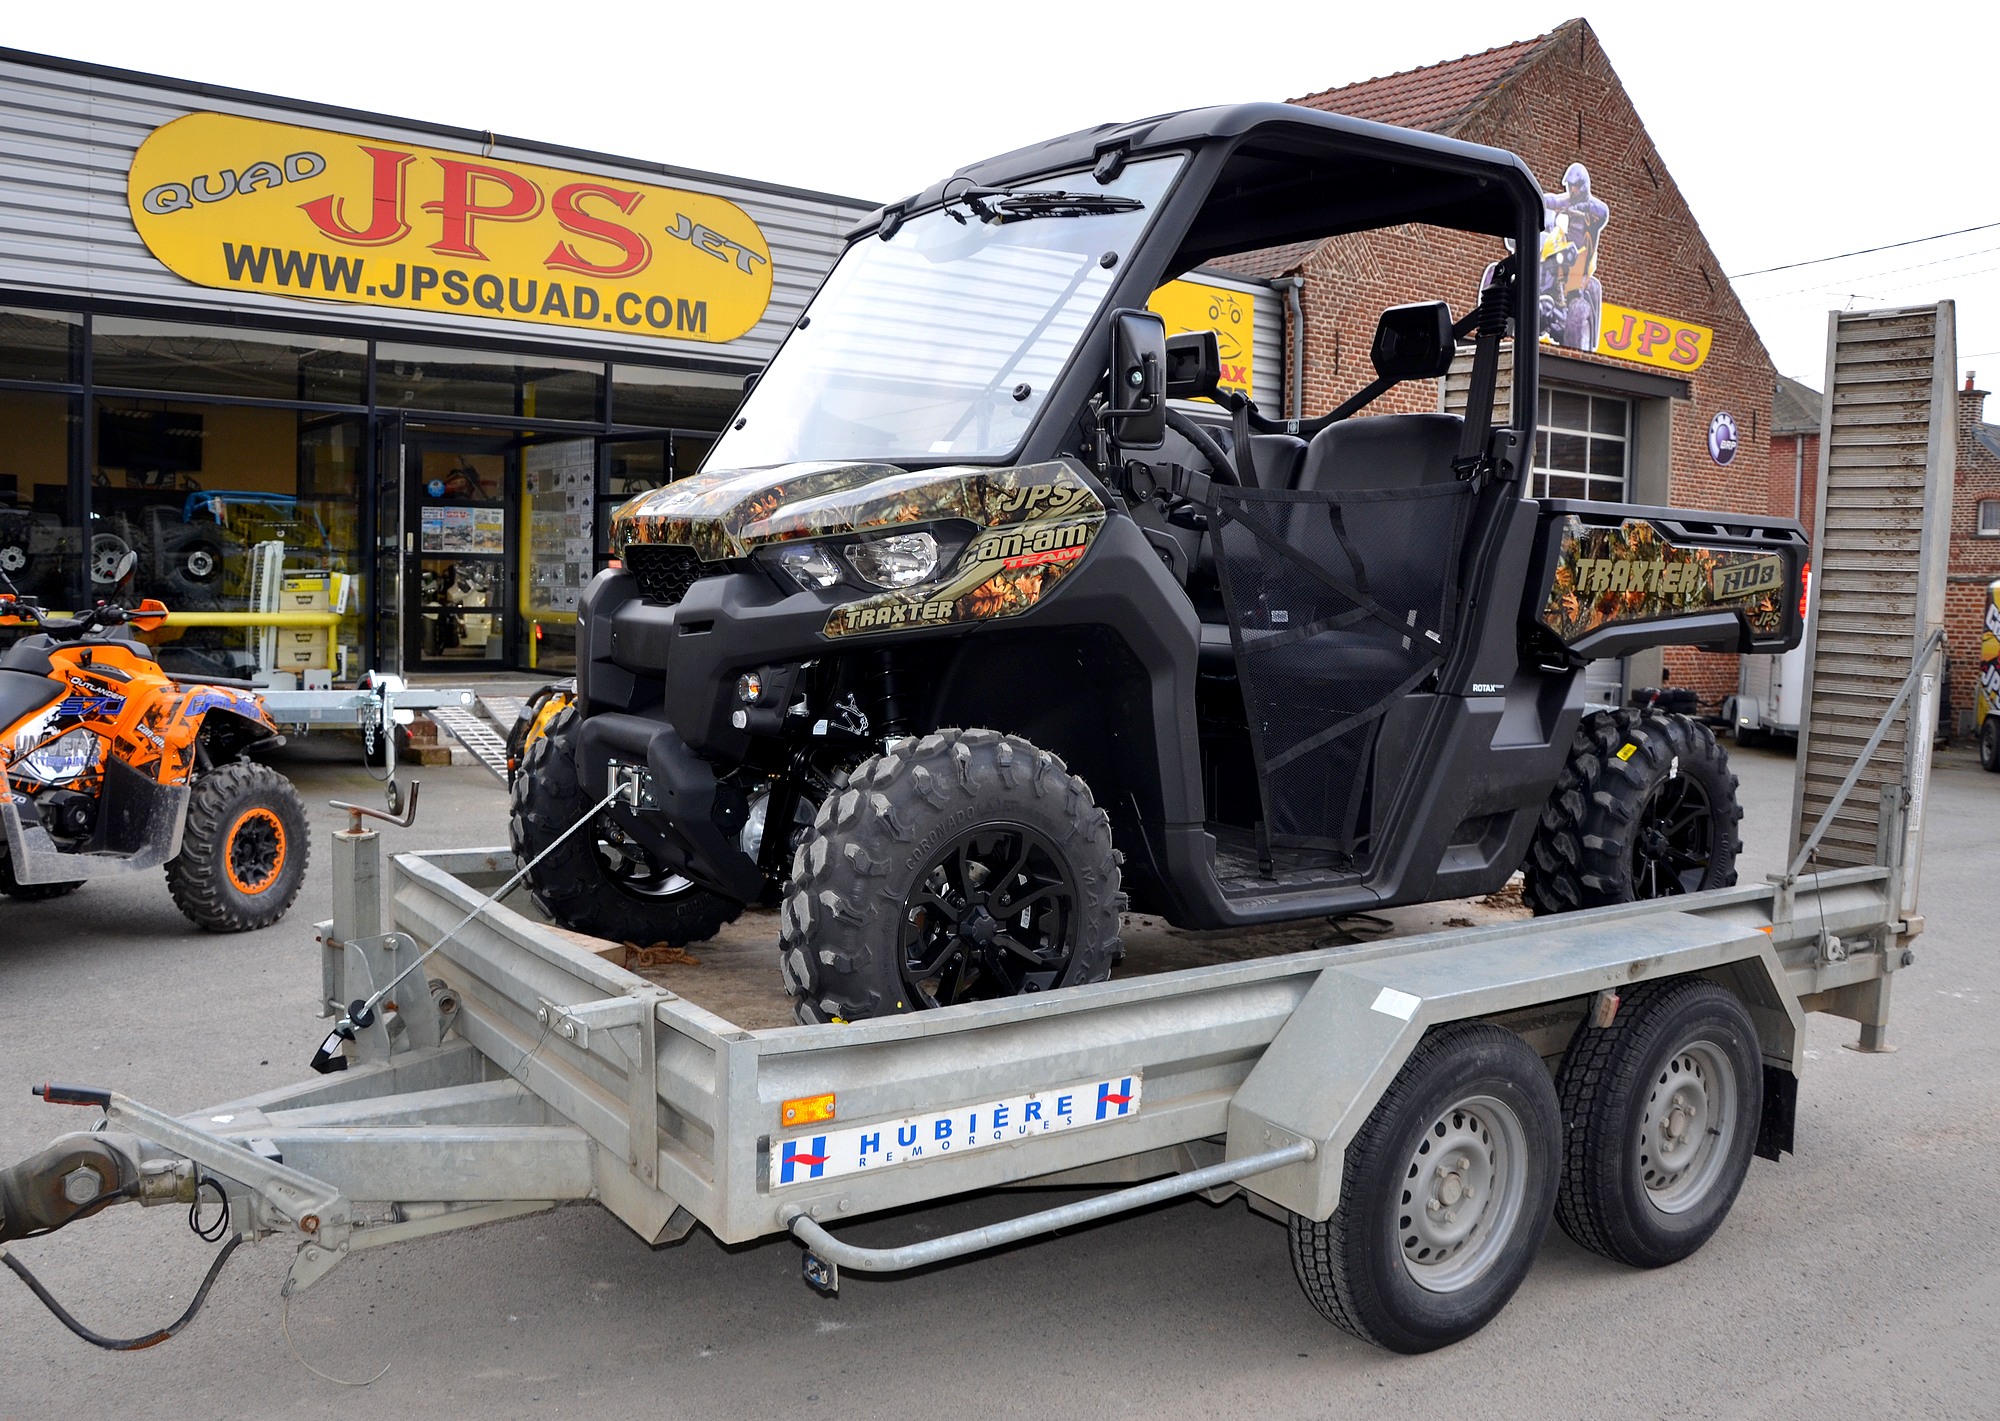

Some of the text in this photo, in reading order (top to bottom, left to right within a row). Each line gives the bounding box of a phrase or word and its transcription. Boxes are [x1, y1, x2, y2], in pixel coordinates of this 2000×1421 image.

[142, 151, 327, 215] QUAD
[296, 144, 653, 279] JPS
[665, 212, 767, 275] JET
[222, 242, 708, 333] WWW.JPSQUAD.COM
[1604, 314, 1702, 365] JPS
[1220, 363, 1247, 384] AX
[1719, 440, 1737, 451] BRP
[1001, 480, 1075, 512] JPS
[957, 523, 1088, 570] can-am
[1008, 547, 1085, 567] TEAM
[1576, 558, 1700, 593] TRAXTER
[845, 600, 953, 629] TRAXTER
[1755, 612, 1781, 626] JPS
[70, 676, 126, 702] OUTLANDER
[1472, 684, 1496, 692] ROTAX
[60, 697, 127, 715] 570
[858, 1115, 1074, 1168] REMORQUES
[859, 1095, 1073, 1156] HUBIÈRE
